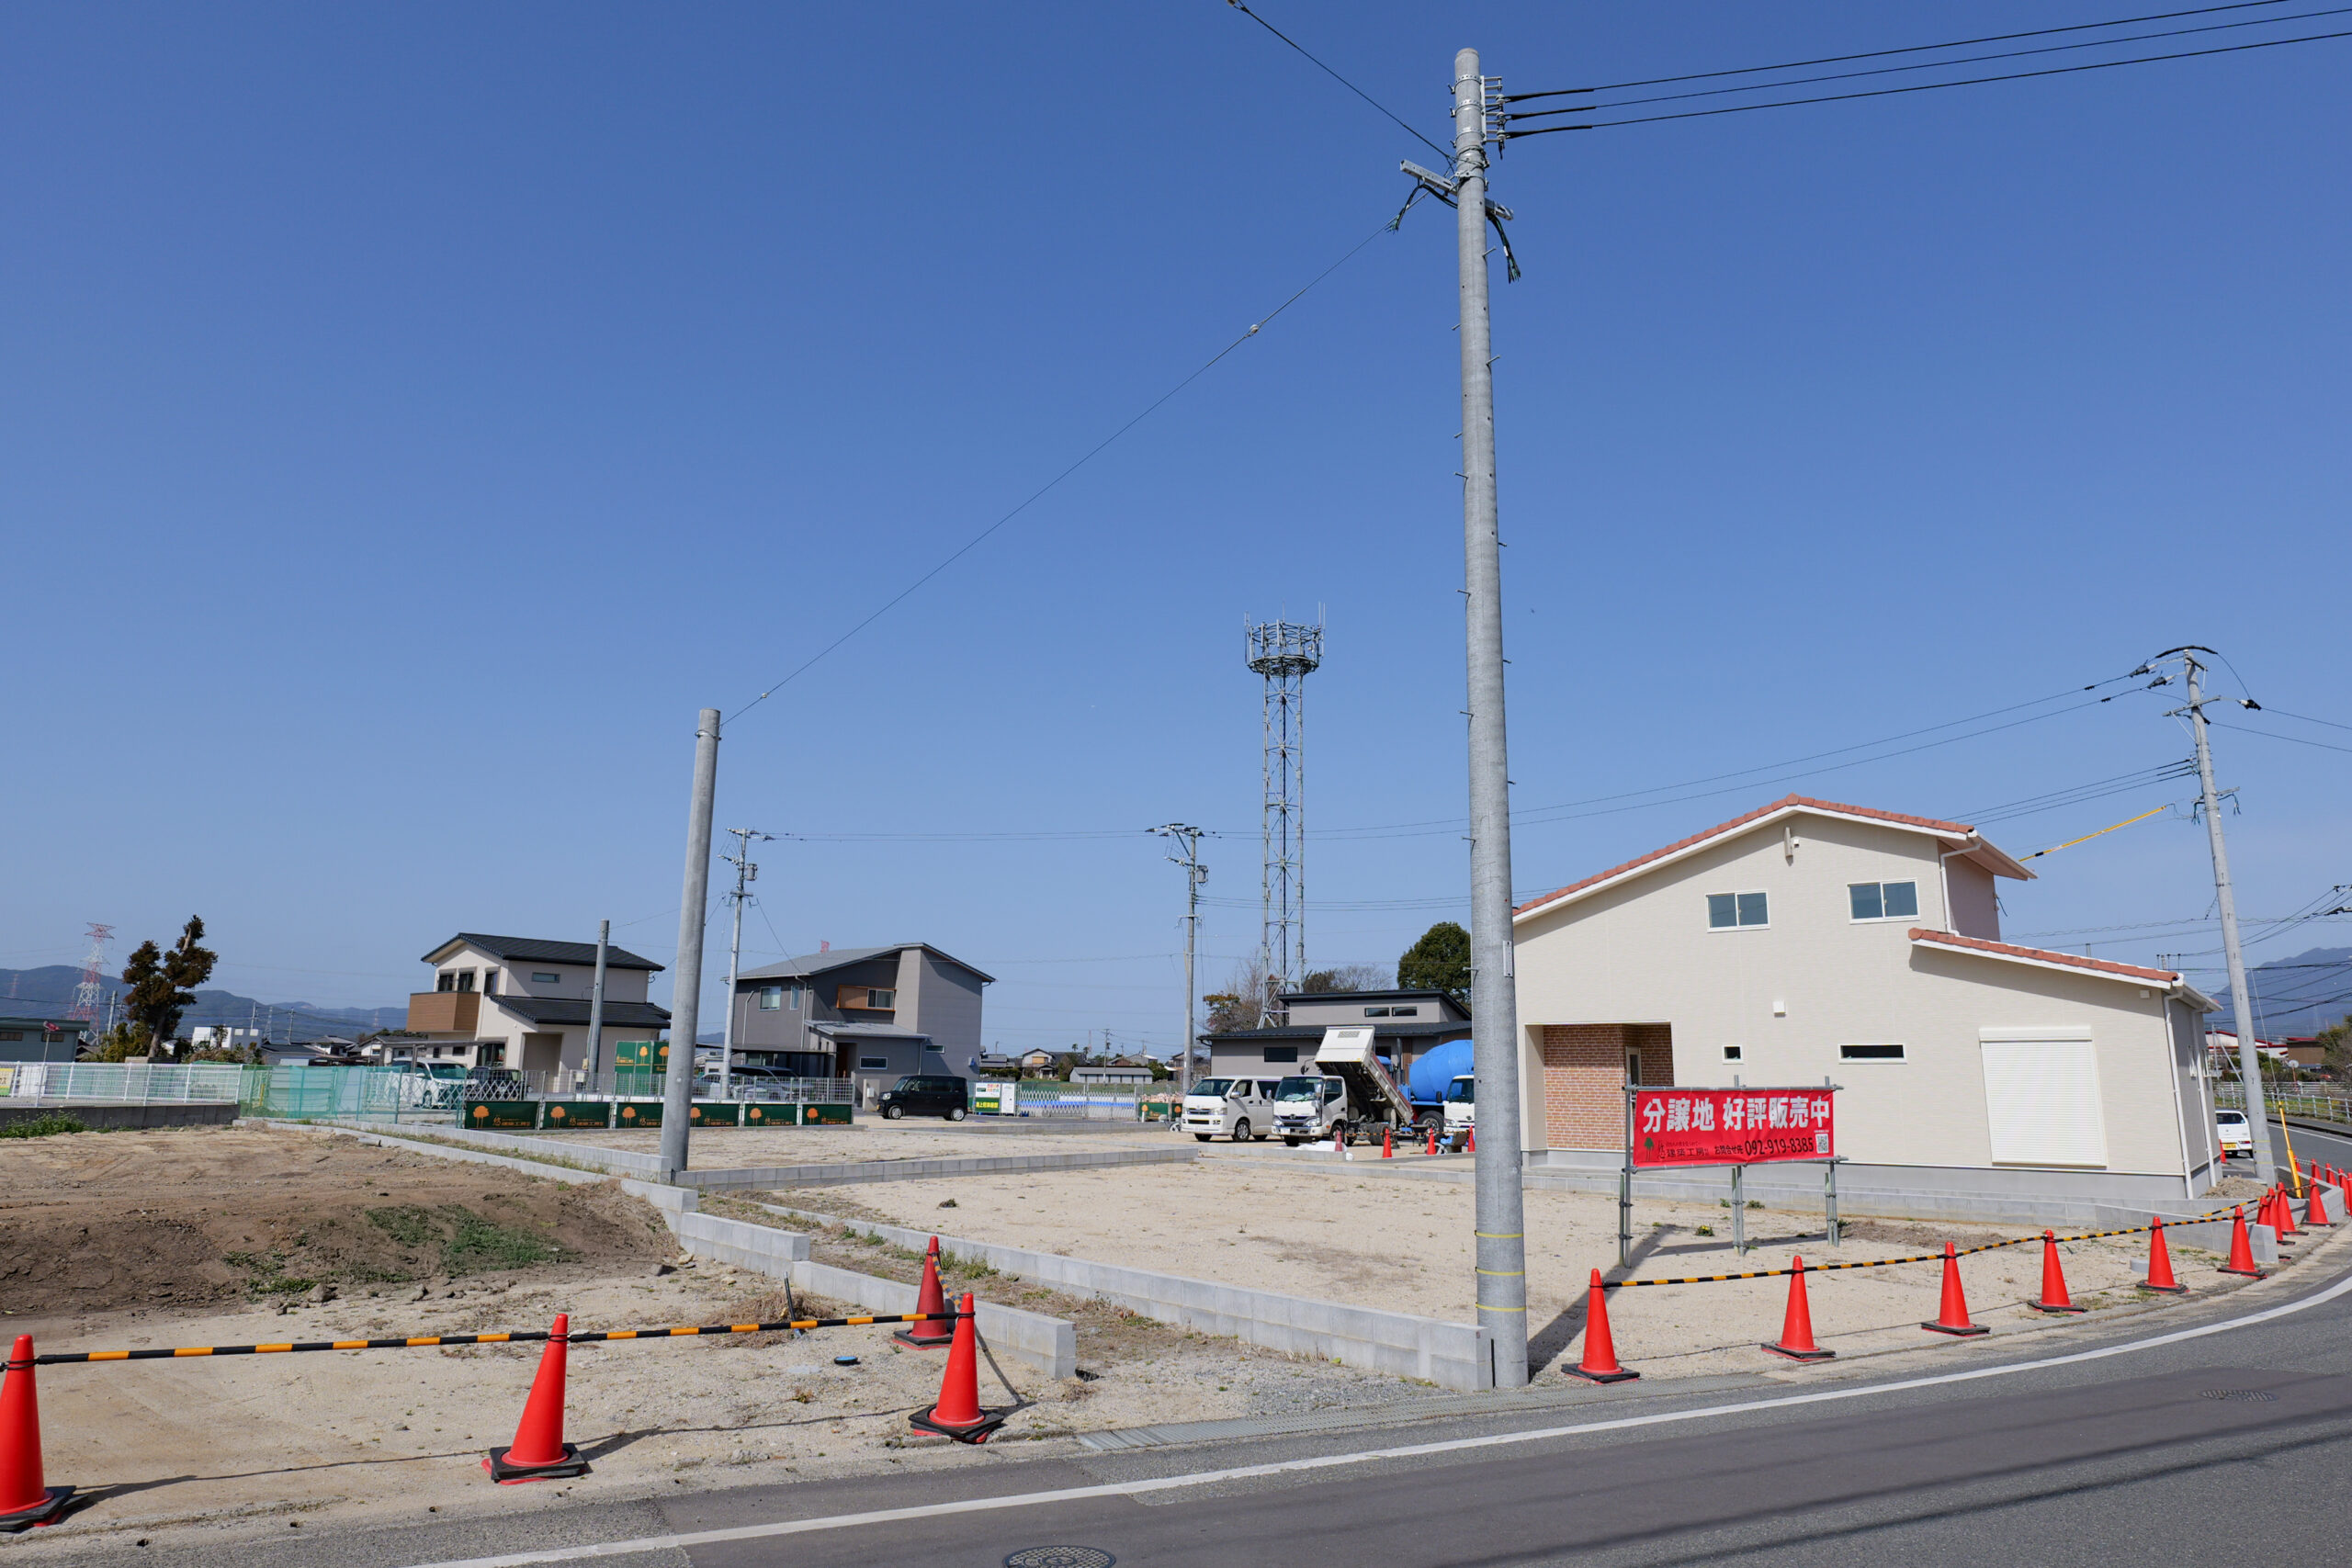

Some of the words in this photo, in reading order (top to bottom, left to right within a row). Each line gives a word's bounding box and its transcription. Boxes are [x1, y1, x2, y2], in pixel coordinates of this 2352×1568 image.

[1643, 1098, 1715, 1133] 分譲地
[1723, 1095, 1829, 1131] 好評販売中
[1744, 1136, 1815, 1156] 092-919-8385
